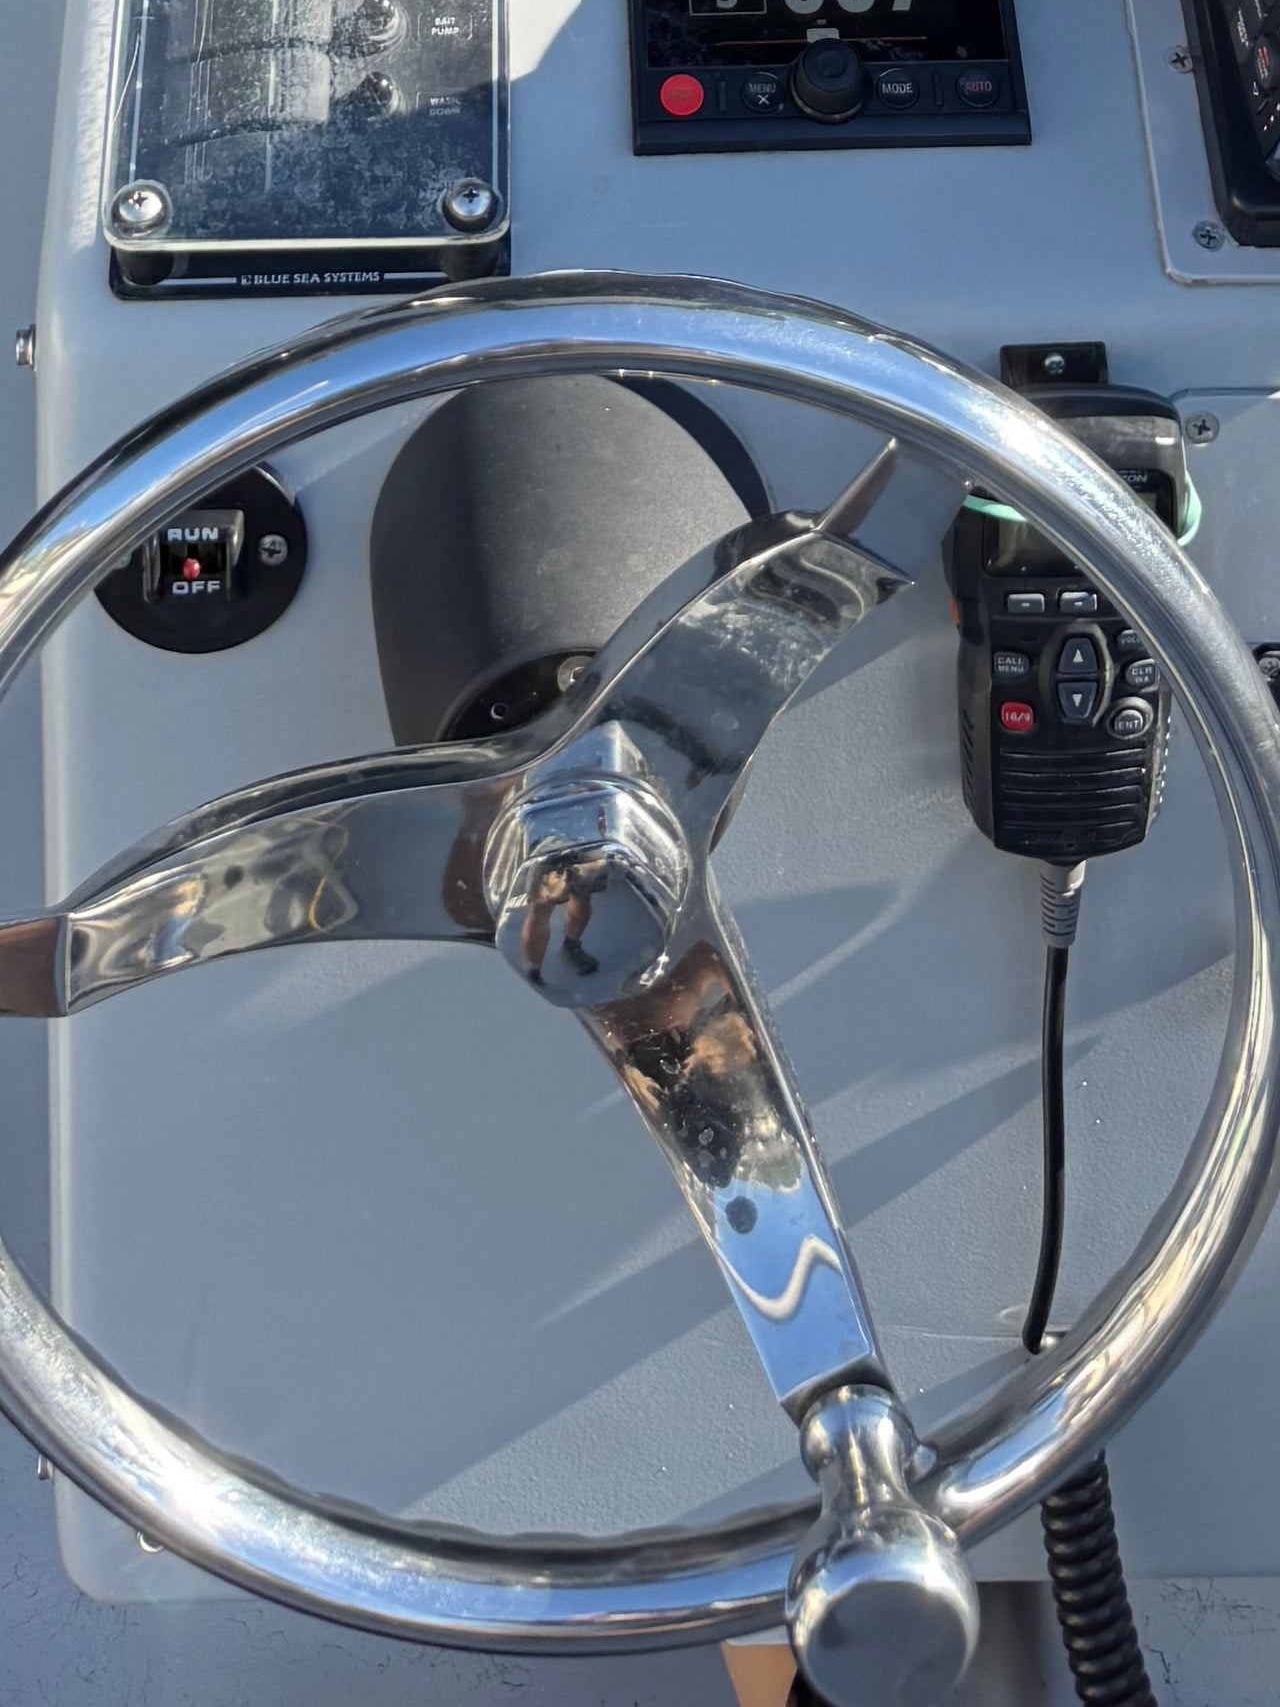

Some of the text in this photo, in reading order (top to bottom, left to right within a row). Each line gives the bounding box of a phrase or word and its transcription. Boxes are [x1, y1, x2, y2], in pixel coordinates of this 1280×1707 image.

[434, 17, 456, 26] BAIT
[431, 27, 459, 36] PUMP
[748, 81, 992, 95] MENU MODE AUTO
[254, 272, 380, 285] BLUE SEA SYSTEMS
[167, 526, 219, 542] RUN
[172, 580, 221, 595] OFF
[997, 656, 1153, 675] CALL CLR
[997, 664, 1024, 673] MENU
[1005, 711, 1031, 722] 16/9
